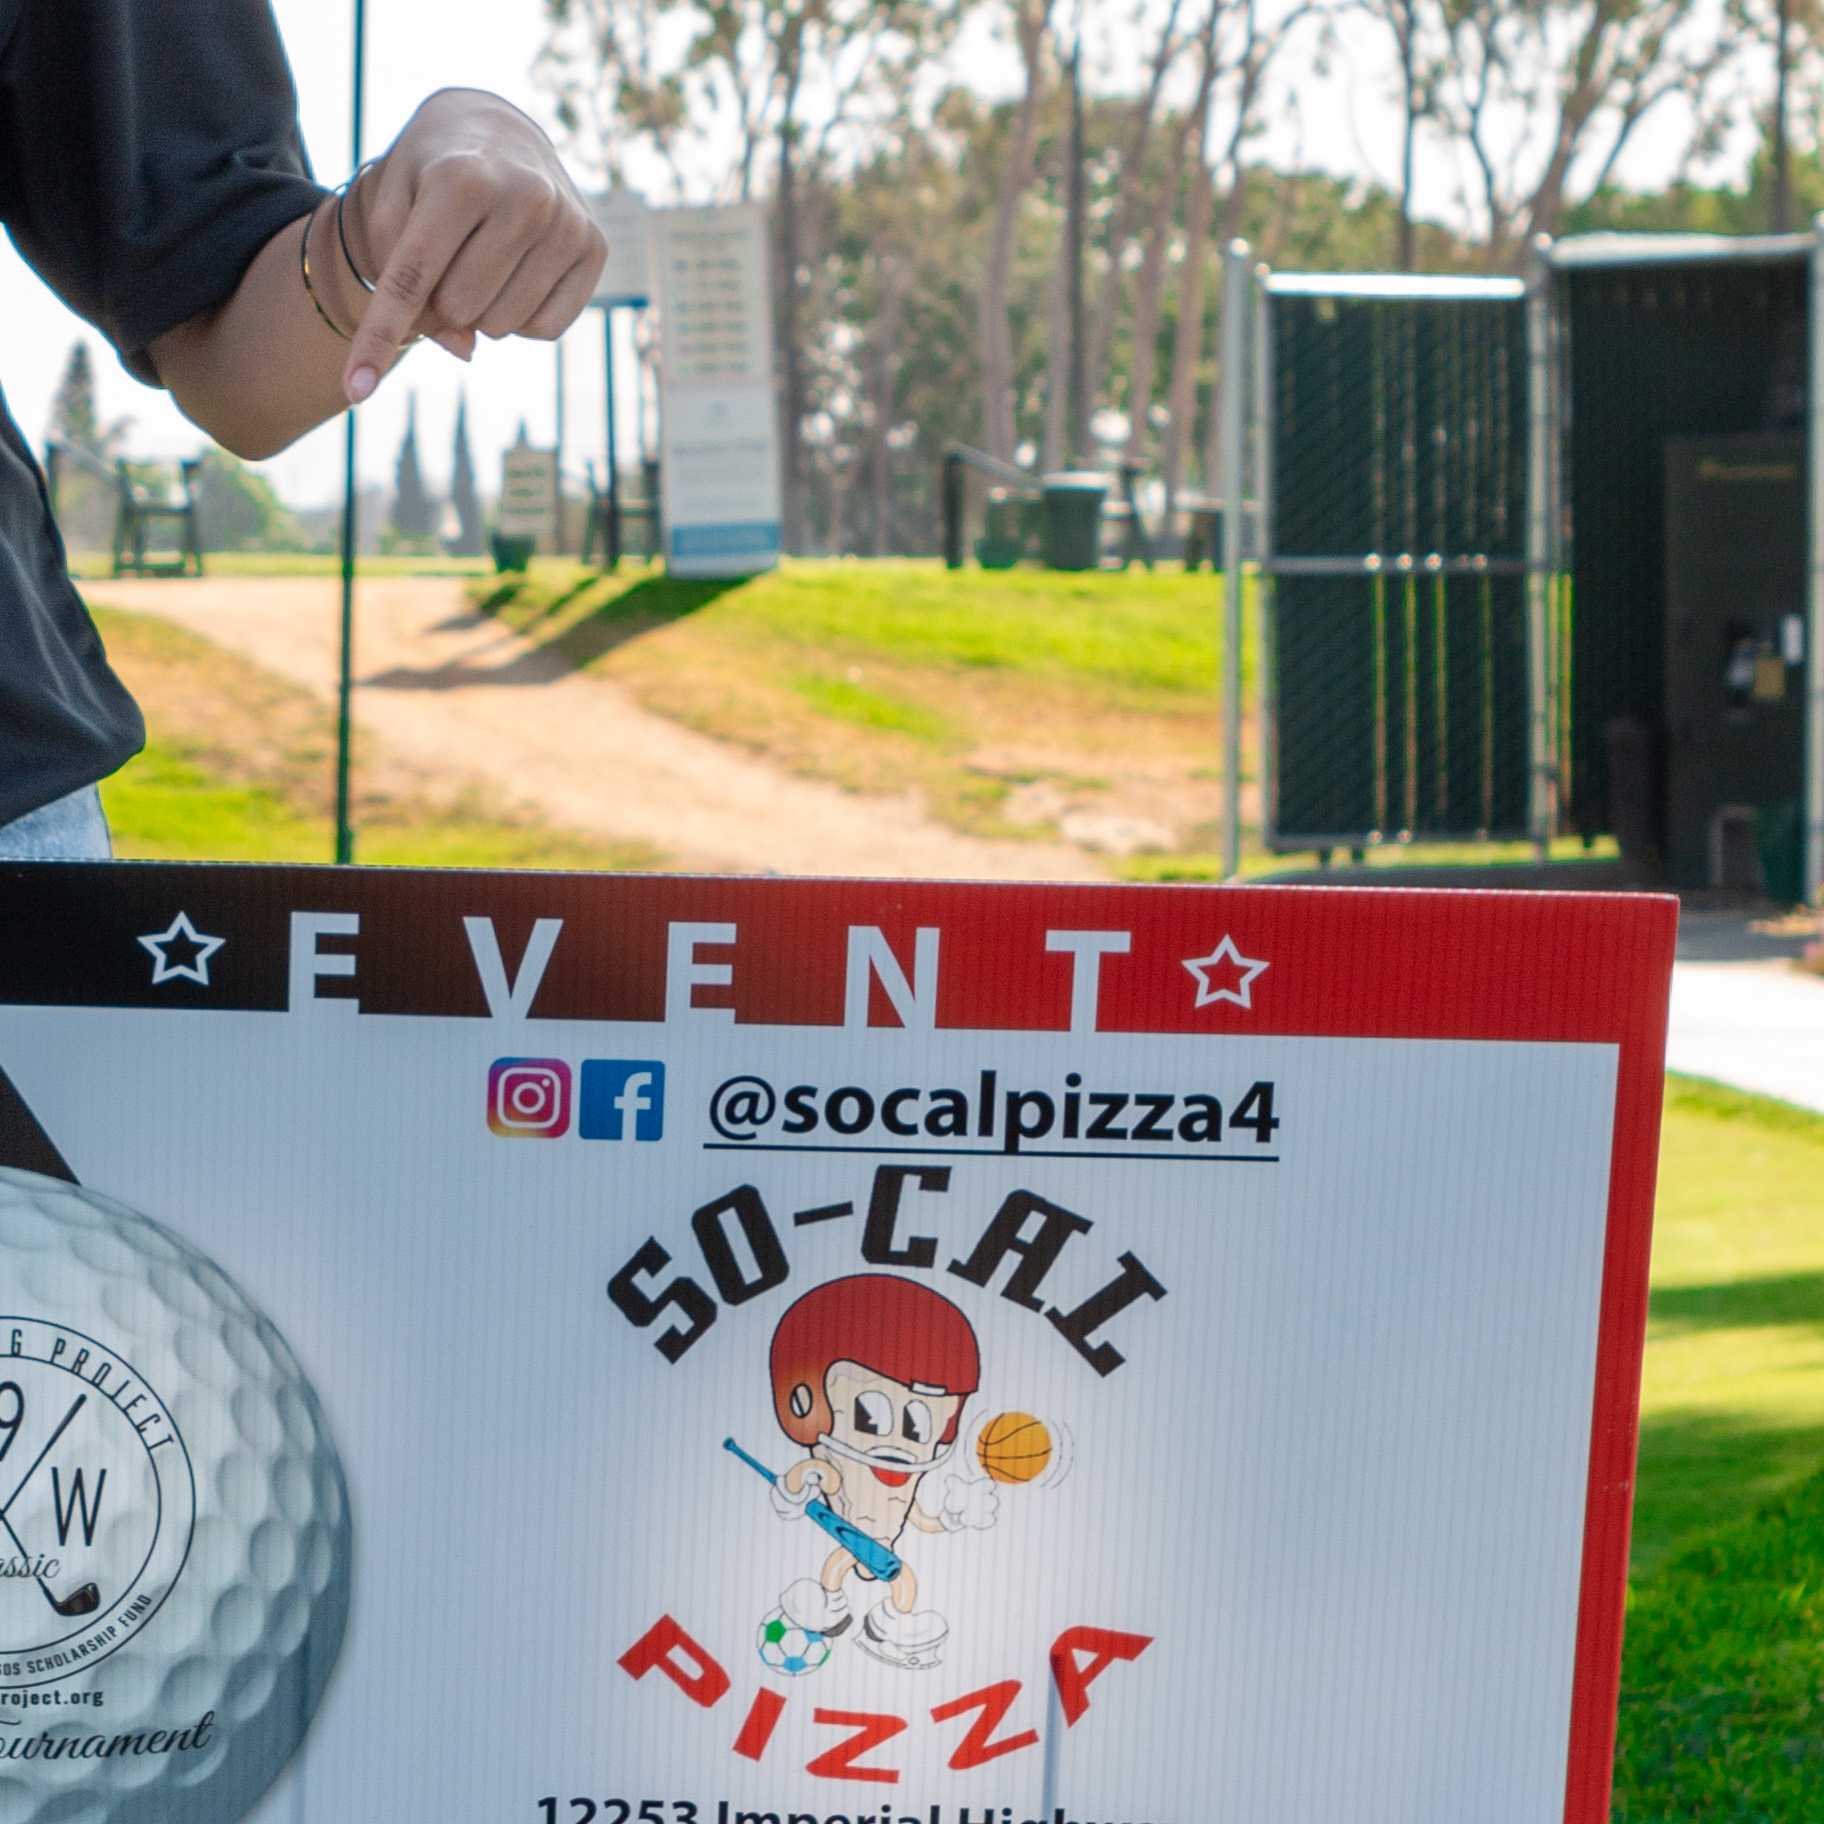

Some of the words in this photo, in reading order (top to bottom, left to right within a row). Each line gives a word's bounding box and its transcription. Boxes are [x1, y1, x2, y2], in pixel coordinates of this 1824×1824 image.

[287, 911, 1132, 1034] EVENT
[709, 1070, 1280, 1153] @socalpizza4
[607, 1164, 1169, 1378] SO-CAL
[51, 1338, 174, 1450] PROJECT
[51, 1466, 107, 1547] W
[27, 1626, 118, 1674] SCHOLARSHIP
[118, 1593, 153, 1628] FUND
[617, 1613, 1155, 1784] PIZZA
